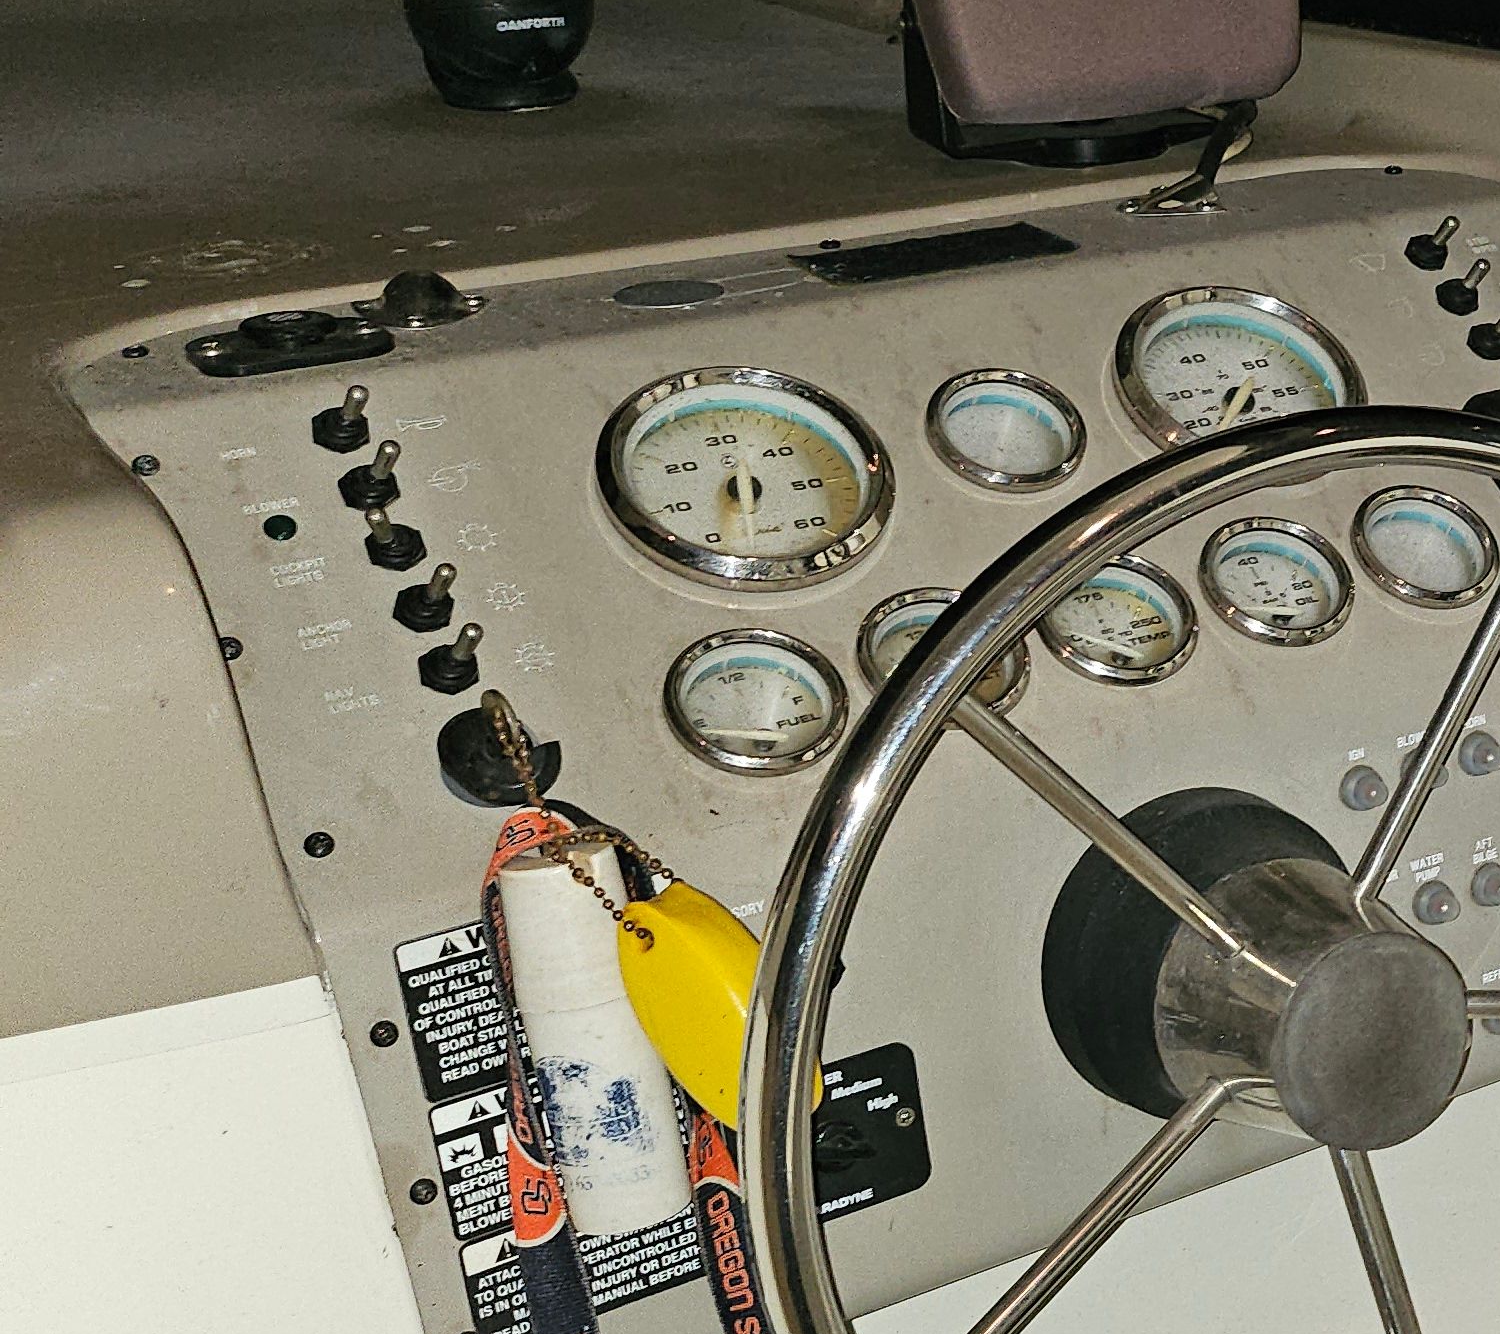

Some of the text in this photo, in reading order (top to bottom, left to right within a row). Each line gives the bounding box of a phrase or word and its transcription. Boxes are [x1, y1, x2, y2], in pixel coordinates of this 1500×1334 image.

[496, 16, 566, 33] DANFORTH
[1179, 353, 1207, 365] 40
[1241, 358, 1270, 372] 50
[1165, 389, 1195, 402] 30
[1271, 385, 1300, 399] 55
[1183, 417, 1213, 430] 20
[704, 434, 738, 448] 30
[762, 445, 795, 458] 40
[664, 460, 699, 475] 20
[790, 478, 824, 492] 50
[243, 496, 299, 515] BLOWER
[662, 500, 693, 515] 10
[793, 516, 827, 530] 60
[704, 532, 722, 544] 0
[1237, 556, 1259, 566] 40
[1073, 592, 1104, 604] 175
[1295, 595, 1320, 606] OIL
[1129, 615, 1162, 629] 250
[1128, 630, 1172, 646] TEMP
[717, 671, 746, 685] 1/2
[792, 696, 805, 708] F
[695, 719, 707, 729] E
[776, 712, 823, 729] FUEL
[1348, 747, 1365, 762] IGN
[1475, 836, 1494, 852] AFT
[1409, 851, 1445, 872] WATER
[1472, 847, 1499, 865] BILGE
[1415, 865, 1441, 883] PUMP
[408, 958, 480, 989] QUALIFIED
[428, 975, 475, 999] AT ALL
[418, 985, 490, 1015] QUALIFIED
[413, 1017, 434, 1033] OF
[425, 1020, 478, 1044] INJURY,
[438, 1033, 476, 1055] BOAT
[438, 1041, 498, 1069] CHANGE
[441, 1062, 480, 1084] READ
[831, 1077, 883, 1100] Medium
[867, 1093, 899, 1112] High
[460, 1154, 510, 1178] GASOL
[448, 1169, 509, 1197] BEFORE
[453, 1180, 510, 1210] 4 MINUT
[455, 1198, 496, 1224] MENT
[457, 1206, 513, 1236] BLOWE
[640, 1223, 683, 1249] WHILE
[592, 1231, 698, 1278] UNCONTROLLED
[706, 1189, 756, 1313] OREGON
[477, 1264, 523, 1290] ATTAC
[591, 1259, 659, 1294] INJURY OR
[592, 1257, 703, 1308] MANUAL BEFORE
[474, 1289, 496, 1305] TO
[479, 1298, 511, 1319] IS IN
